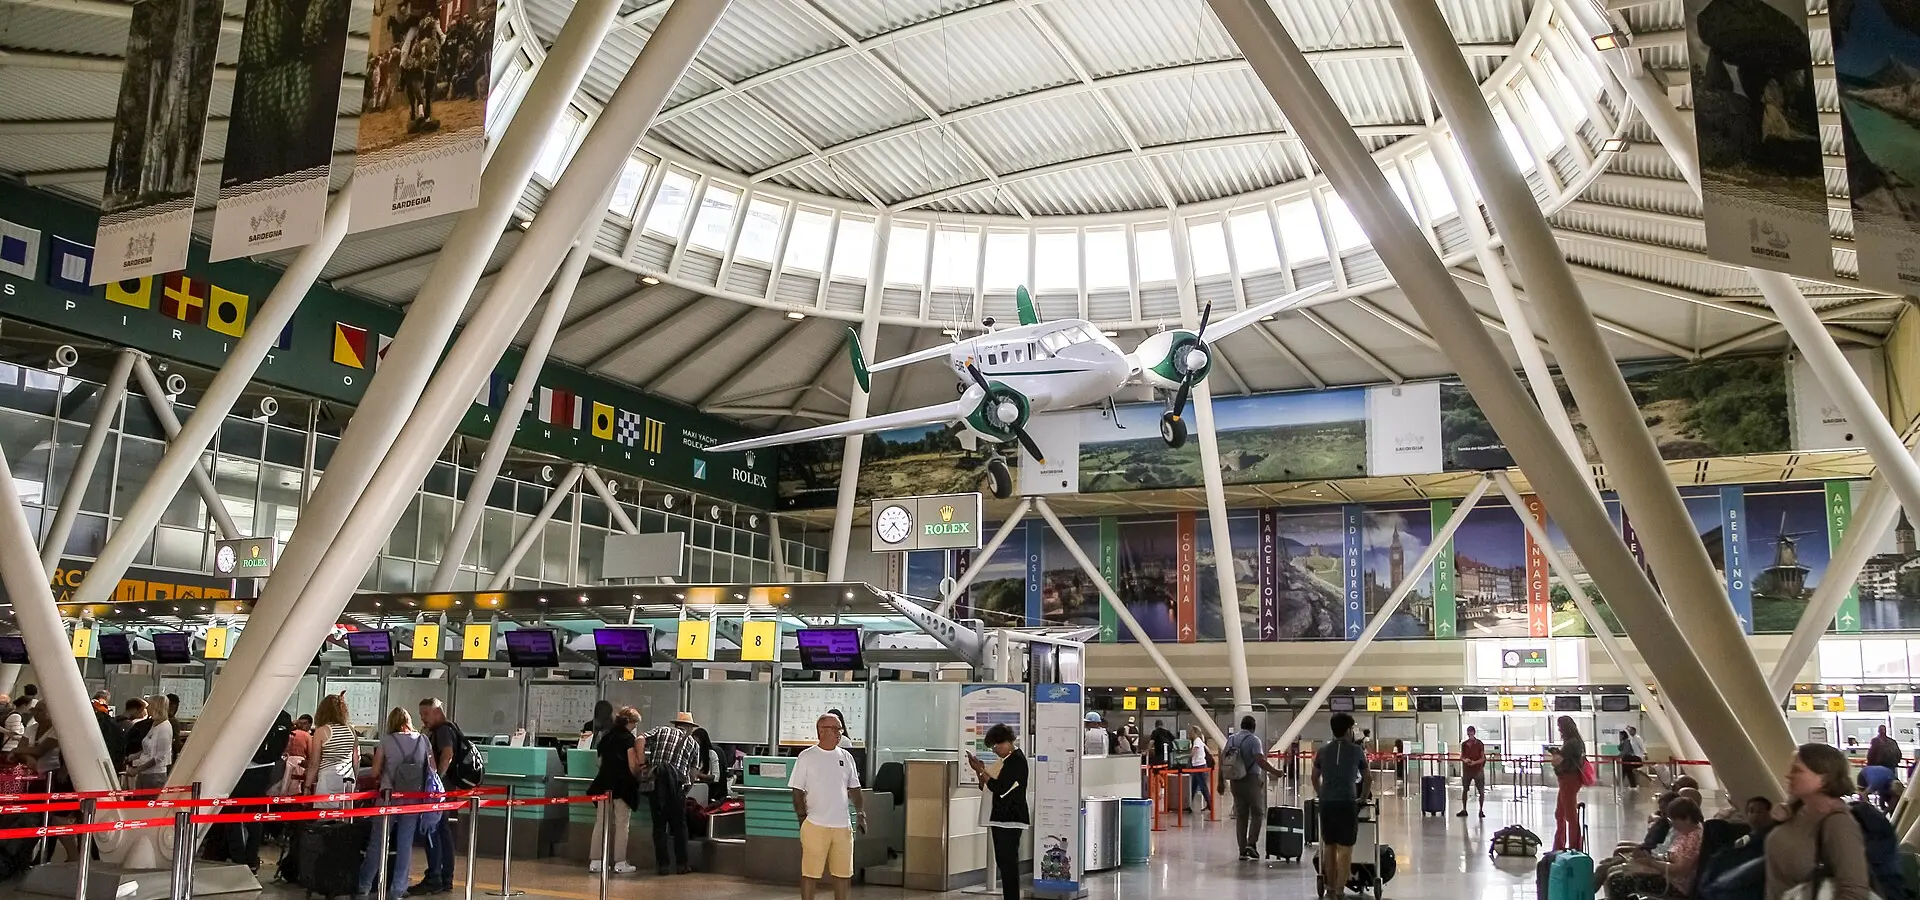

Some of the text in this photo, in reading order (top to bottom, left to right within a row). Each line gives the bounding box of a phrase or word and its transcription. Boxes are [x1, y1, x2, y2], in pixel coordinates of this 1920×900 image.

[391, 195, 431, 210] SARDEGNA
[248, 229, 283, 242] SARDEGNA
[1750, 246, 1791, 260] SARDEGNA
[123, 256, 152, 268] SARDEGNA
[682, 428, 718, 445] MAXI YACHT
[682, 437, 703, 450] ROLEX
[732, 467, 767, 488] ROLEX
[924, 522, 970, 535] ROLEX
[1729, 509, 1744, 591] BERLINO
[243, 558, 268, 568] ROLEX
[1104, 545, 1113, 585] PRAG
[1182, 533, 1191, 603] COLONIA
[1264, 514, 1273, 618] BARCELLONA
[1348, 515, 1360, 611] EDIMBURGO
[79, 639, 84, 648] 2
[213, 638, 219, 648] 3
[422, 636, 429, 647] 5
[473, 636, 480, 648] 6
[690, 634, 697, 646] 7
[755, 635, 762, 647] 8
